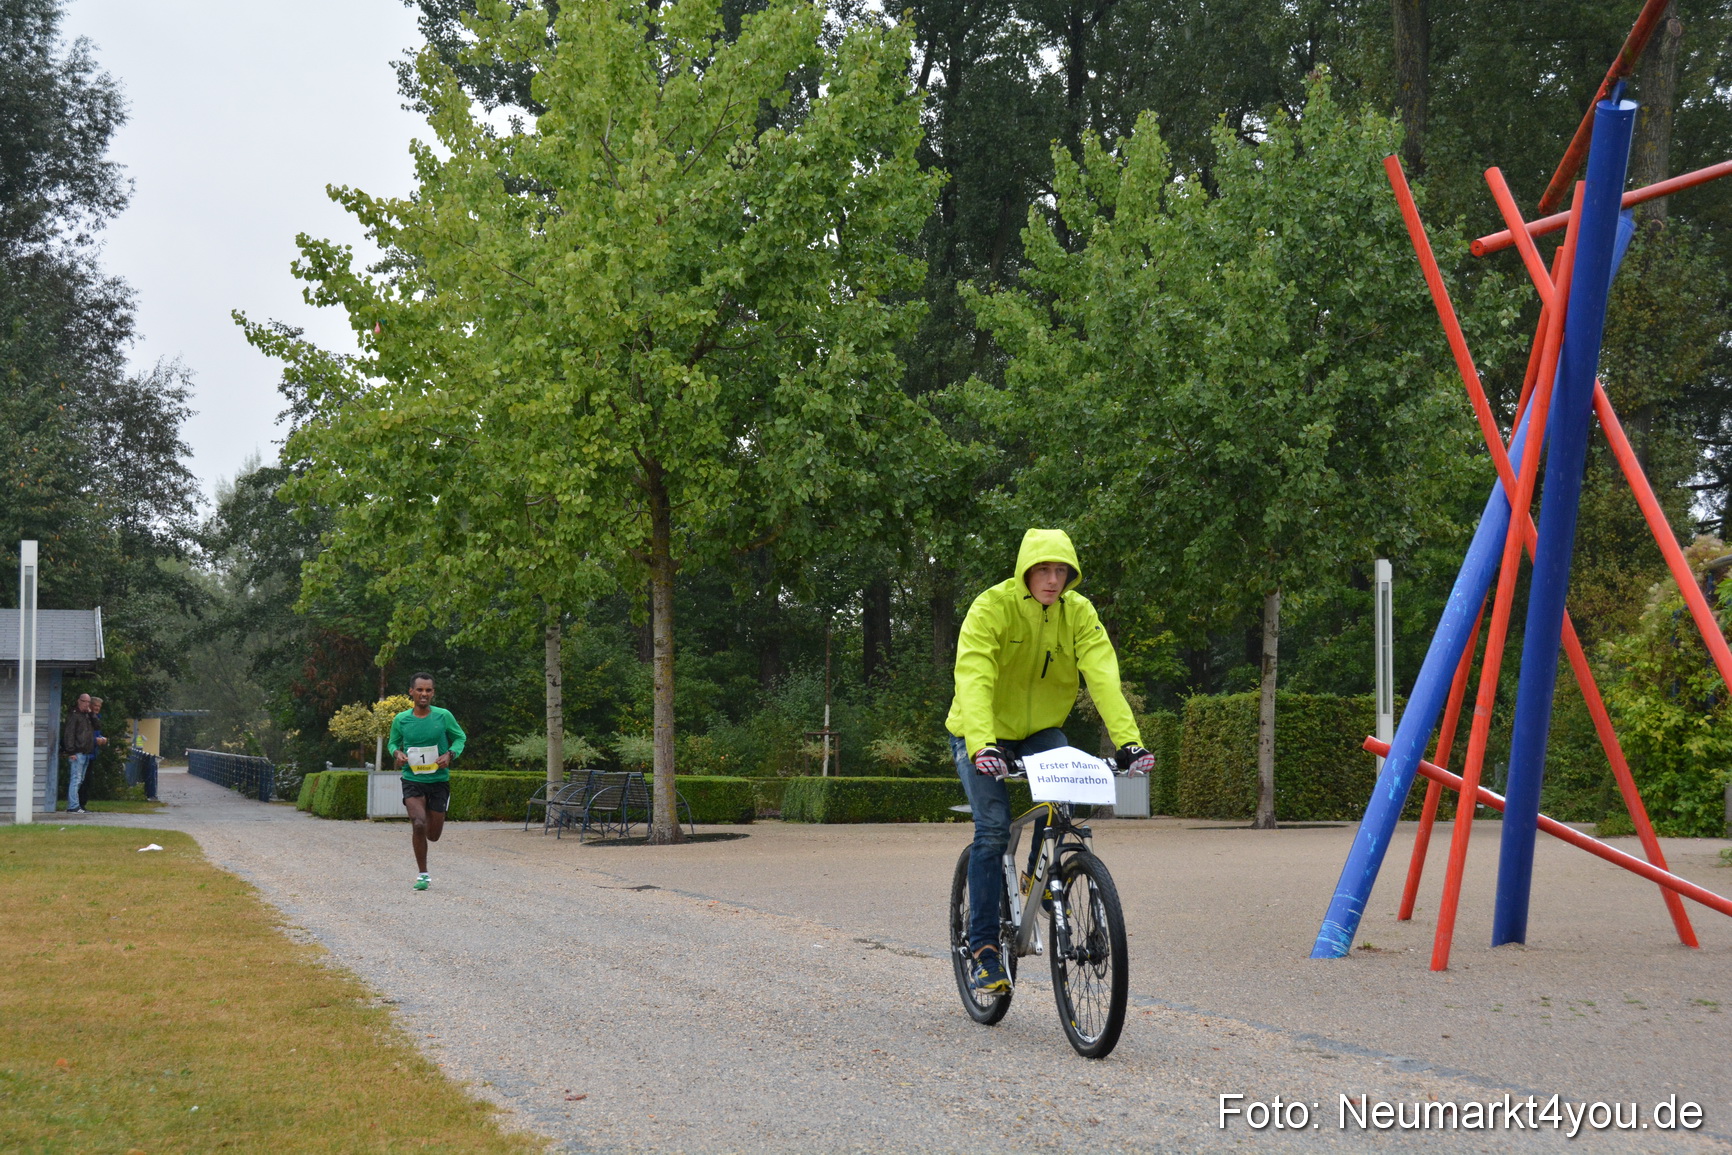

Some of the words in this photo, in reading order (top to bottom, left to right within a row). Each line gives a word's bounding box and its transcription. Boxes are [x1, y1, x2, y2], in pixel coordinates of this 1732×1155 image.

[420, 754, 425, 764] 1
[1072, 762, 1100, 770] Mann
[1038, 775, 1108, 784] Halbmarathon
